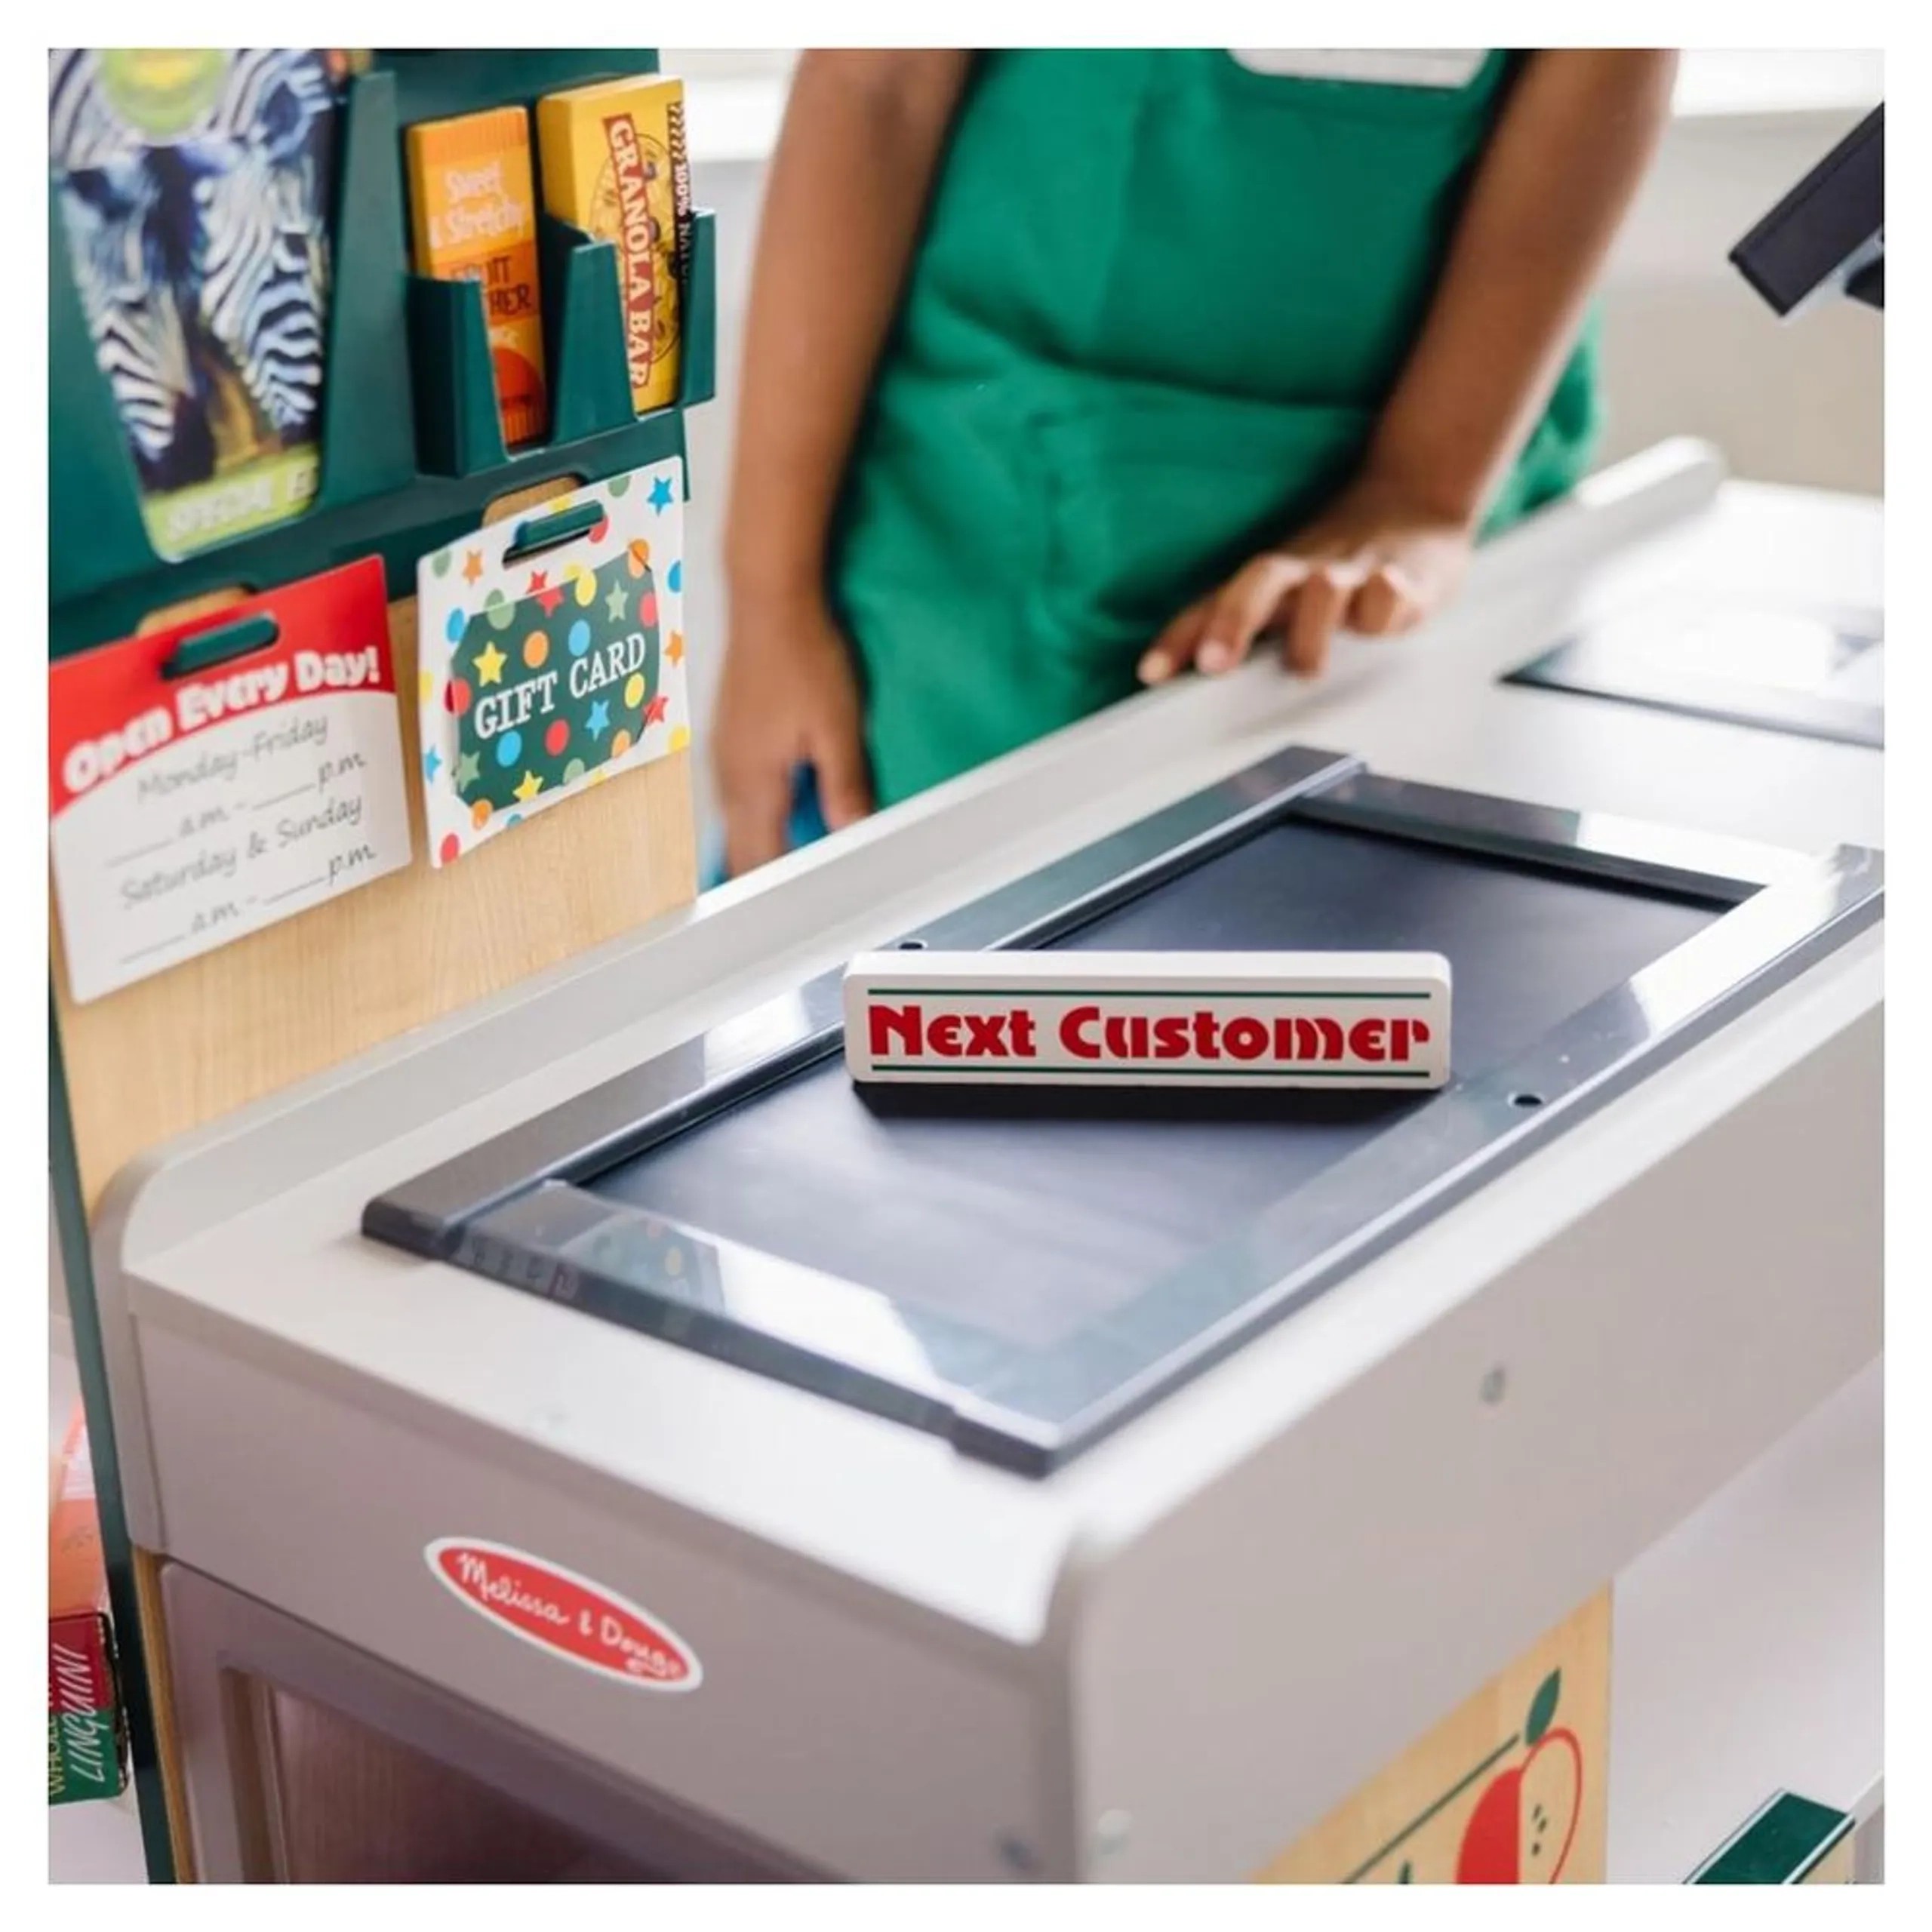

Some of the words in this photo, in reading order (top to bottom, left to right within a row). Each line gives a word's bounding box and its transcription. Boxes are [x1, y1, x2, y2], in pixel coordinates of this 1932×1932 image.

[608, 118, 654, 302] GRANOLA
[629, 316, 651, 389] BAR
[62, 706, 172, 794] Open
[175, 660, 288, 731] Every
[294, 645, 381, 693] Day!
[473, 669, 558, 740] GIFT
[569, 632, 646, 699] CARD
[119, 844, 237, 910] Saturday
[276, 795, 363, 849] Sunday
[868, 1004, 1037, 1057] Next
[1058, 1005, 1431, 1062] Customer
[456, 1552, 571, 1627] Melissa
[51, 1642, 110, 1783] LINGUINI
